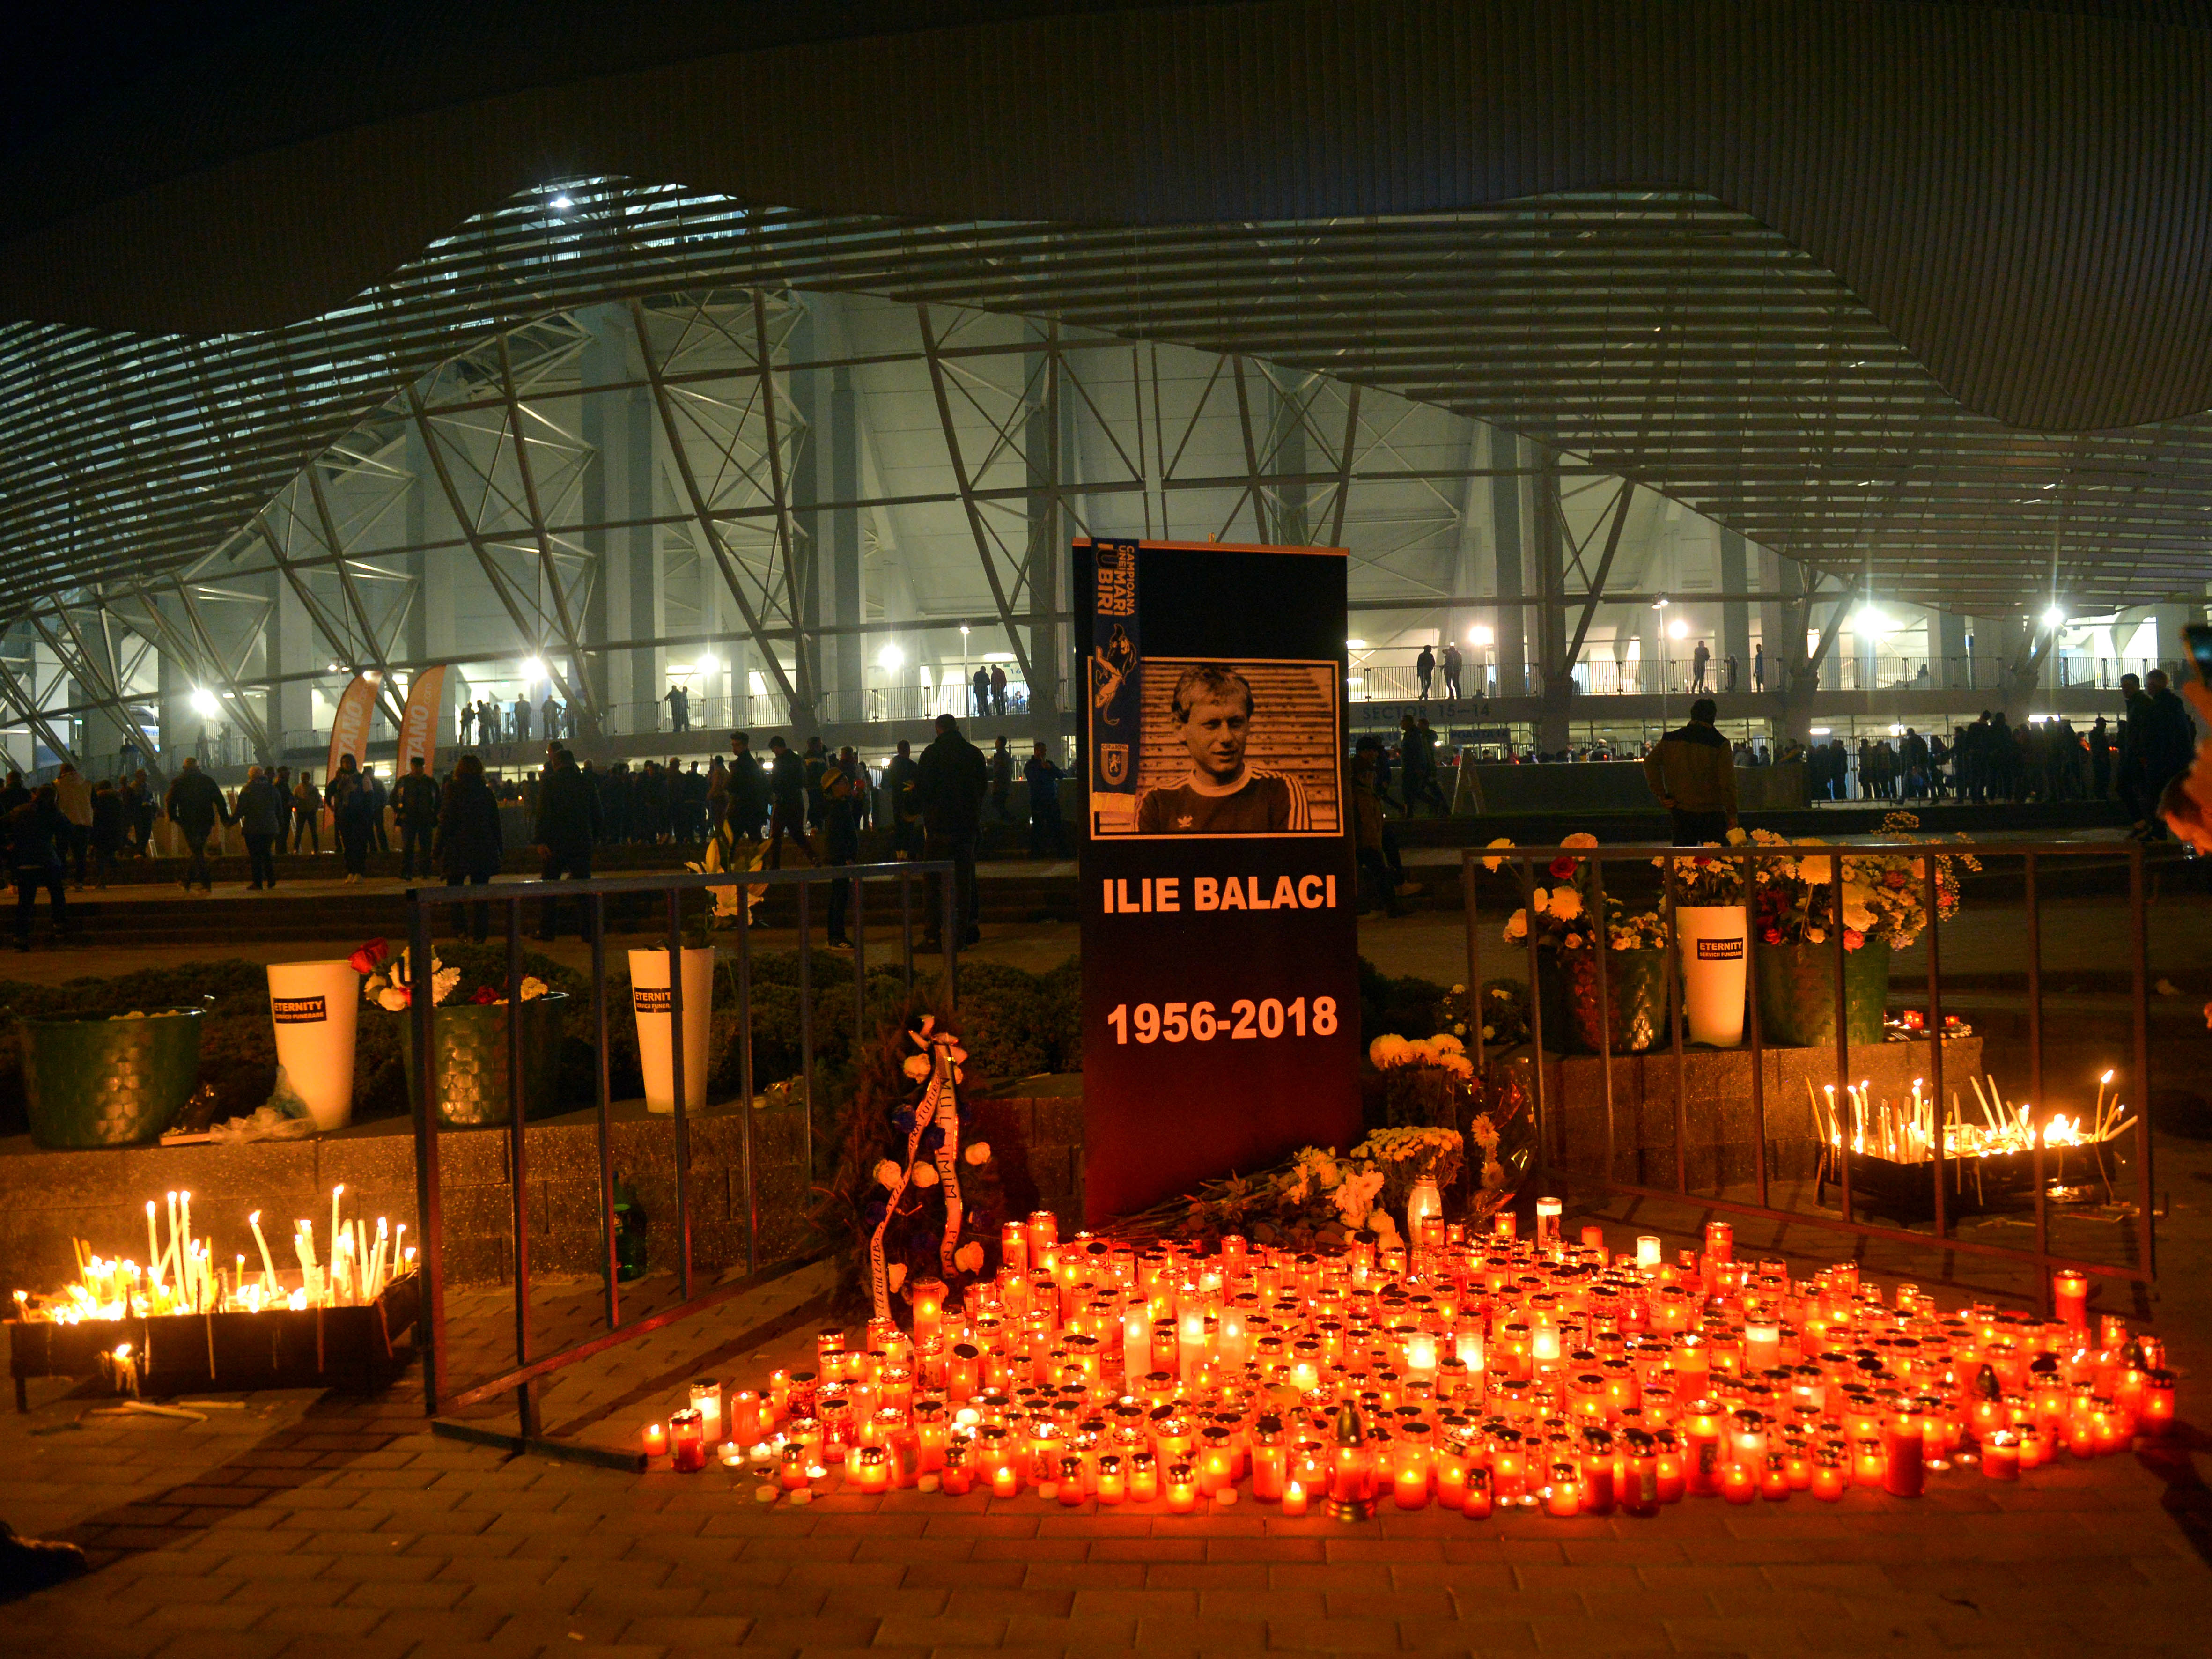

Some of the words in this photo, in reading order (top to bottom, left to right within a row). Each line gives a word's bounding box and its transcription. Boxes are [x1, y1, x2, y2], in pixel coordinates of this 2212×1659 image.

[1113, 570, 1126, 616] MARI
[1127, 545, 1135, 616] CAMPIOANA
[1362, 705, 1427, 720] SECTOR
[1103, 877, 1180, 913] ILIE
[1194, 874, 1336, 911] BALACI
[1699, 942, 1742, 951] ETERNITY
[274, 1000, 323, 1012] ETERNITY
[1107, 996, 1338, 1045] 1956-2018
